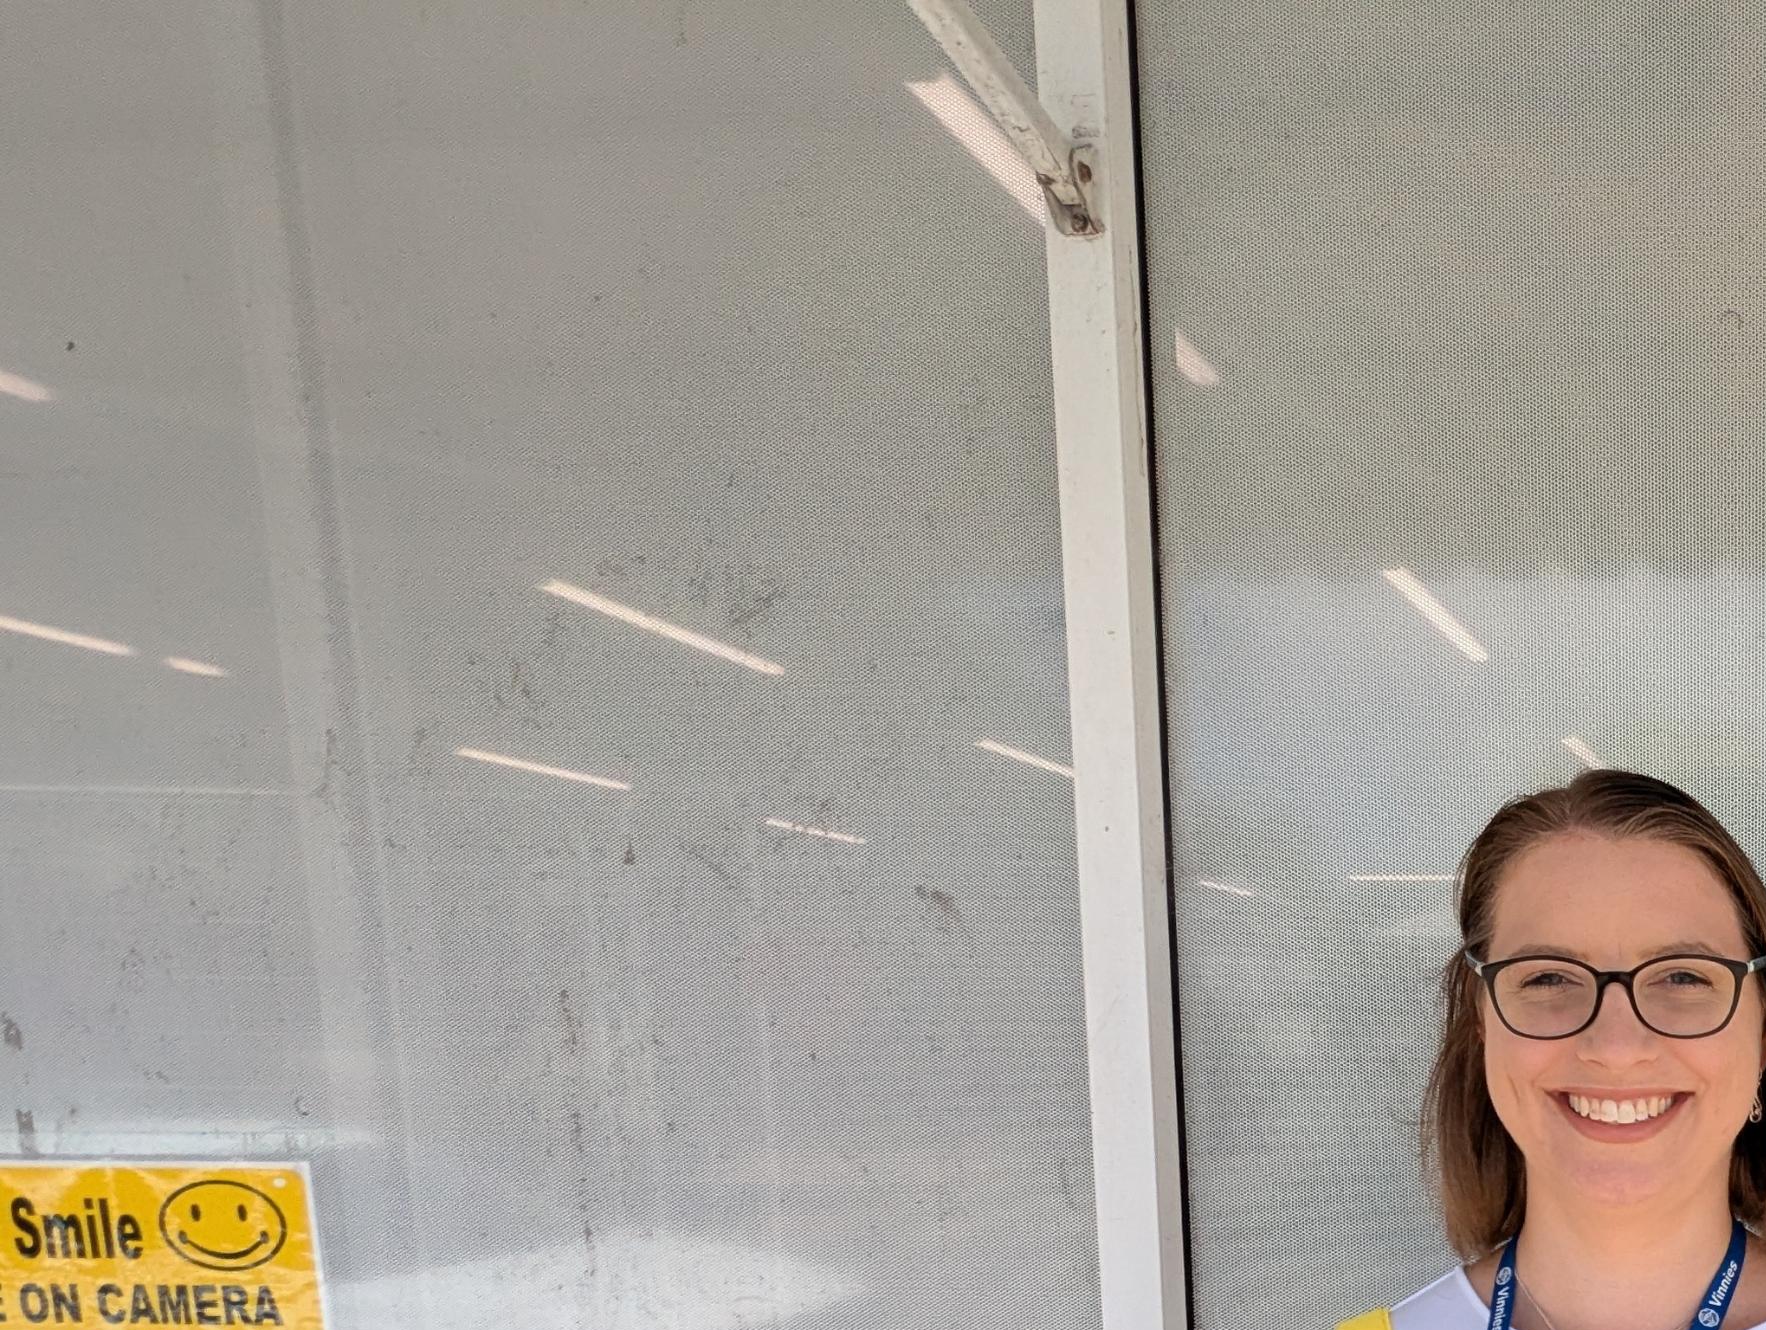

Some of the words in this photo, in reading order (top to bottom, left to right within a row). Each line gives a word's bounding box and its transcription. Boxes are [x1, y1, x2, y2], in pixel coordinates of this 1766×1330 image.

[10, 1197, 143, 1260] Smile
[20, 1283, 82, 1323] ON
[97, 1284, 284, 1327] CAMERA
[1709, 1260, 1738, 1308] Vinnies
